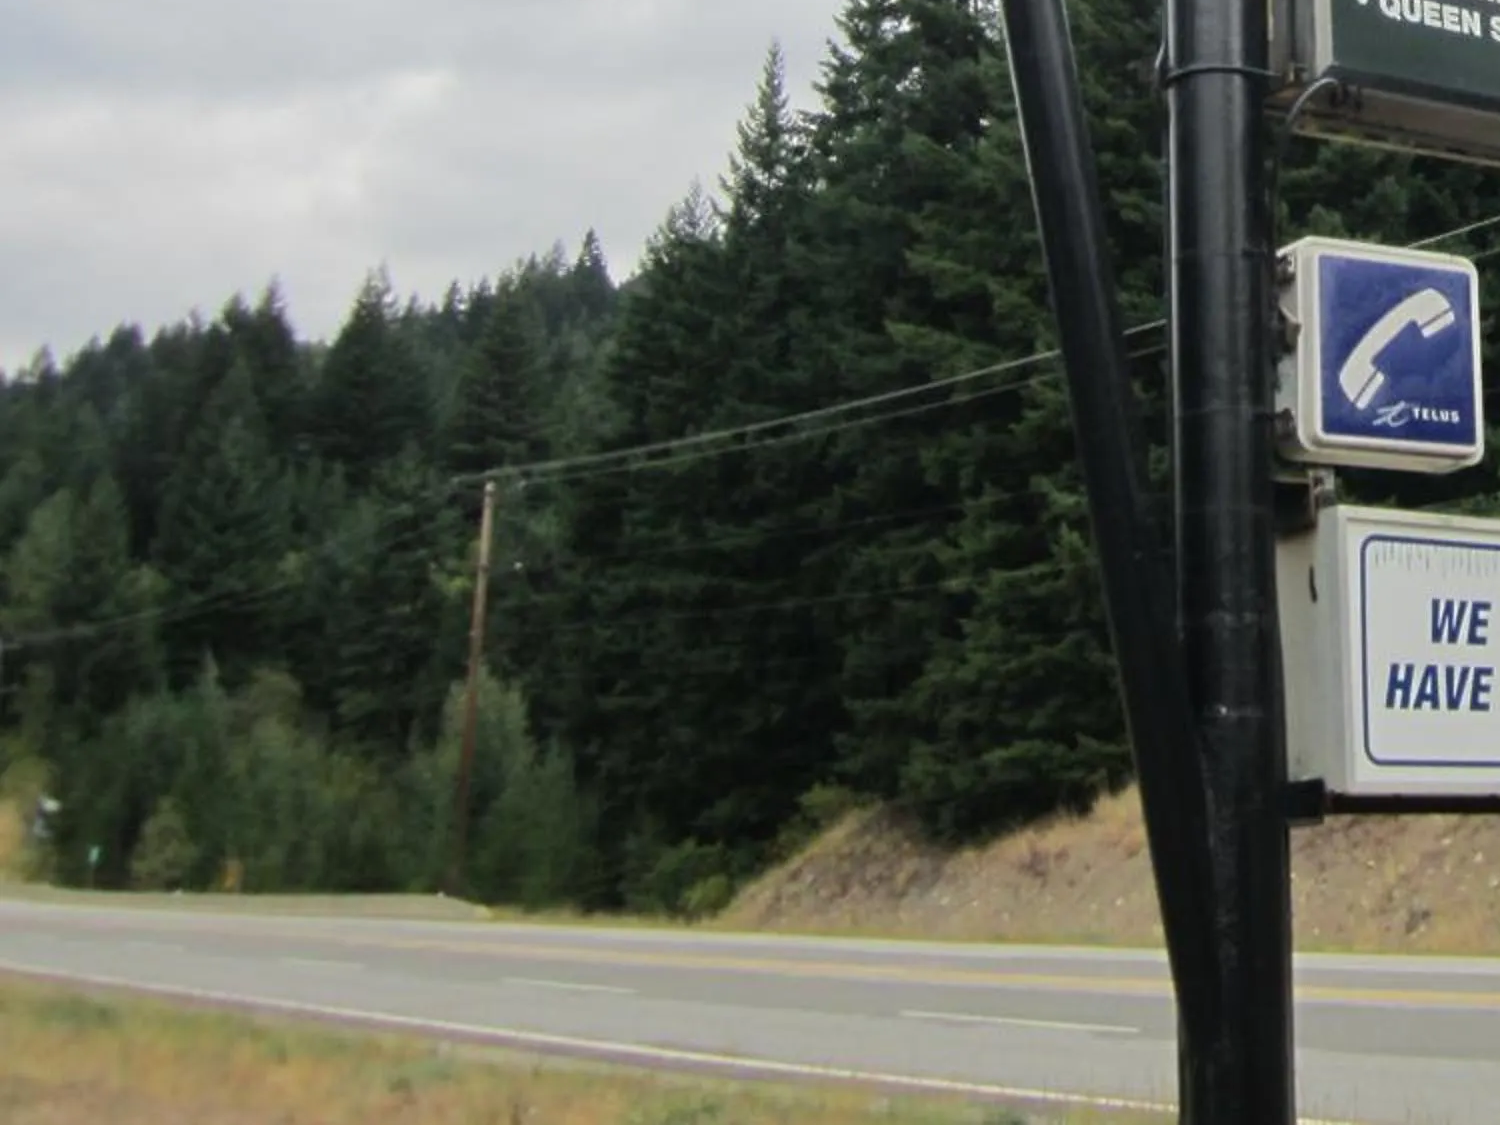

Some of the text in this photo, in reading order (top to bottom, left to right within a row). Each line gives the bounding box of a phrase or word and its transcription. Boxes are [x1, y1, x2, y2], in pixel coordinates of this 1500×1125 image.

[1412, 407, 1460, 423] TELUS
[1430, 597, 1492, 646] WE
[1385, 662, 1494, 711] HAVE
